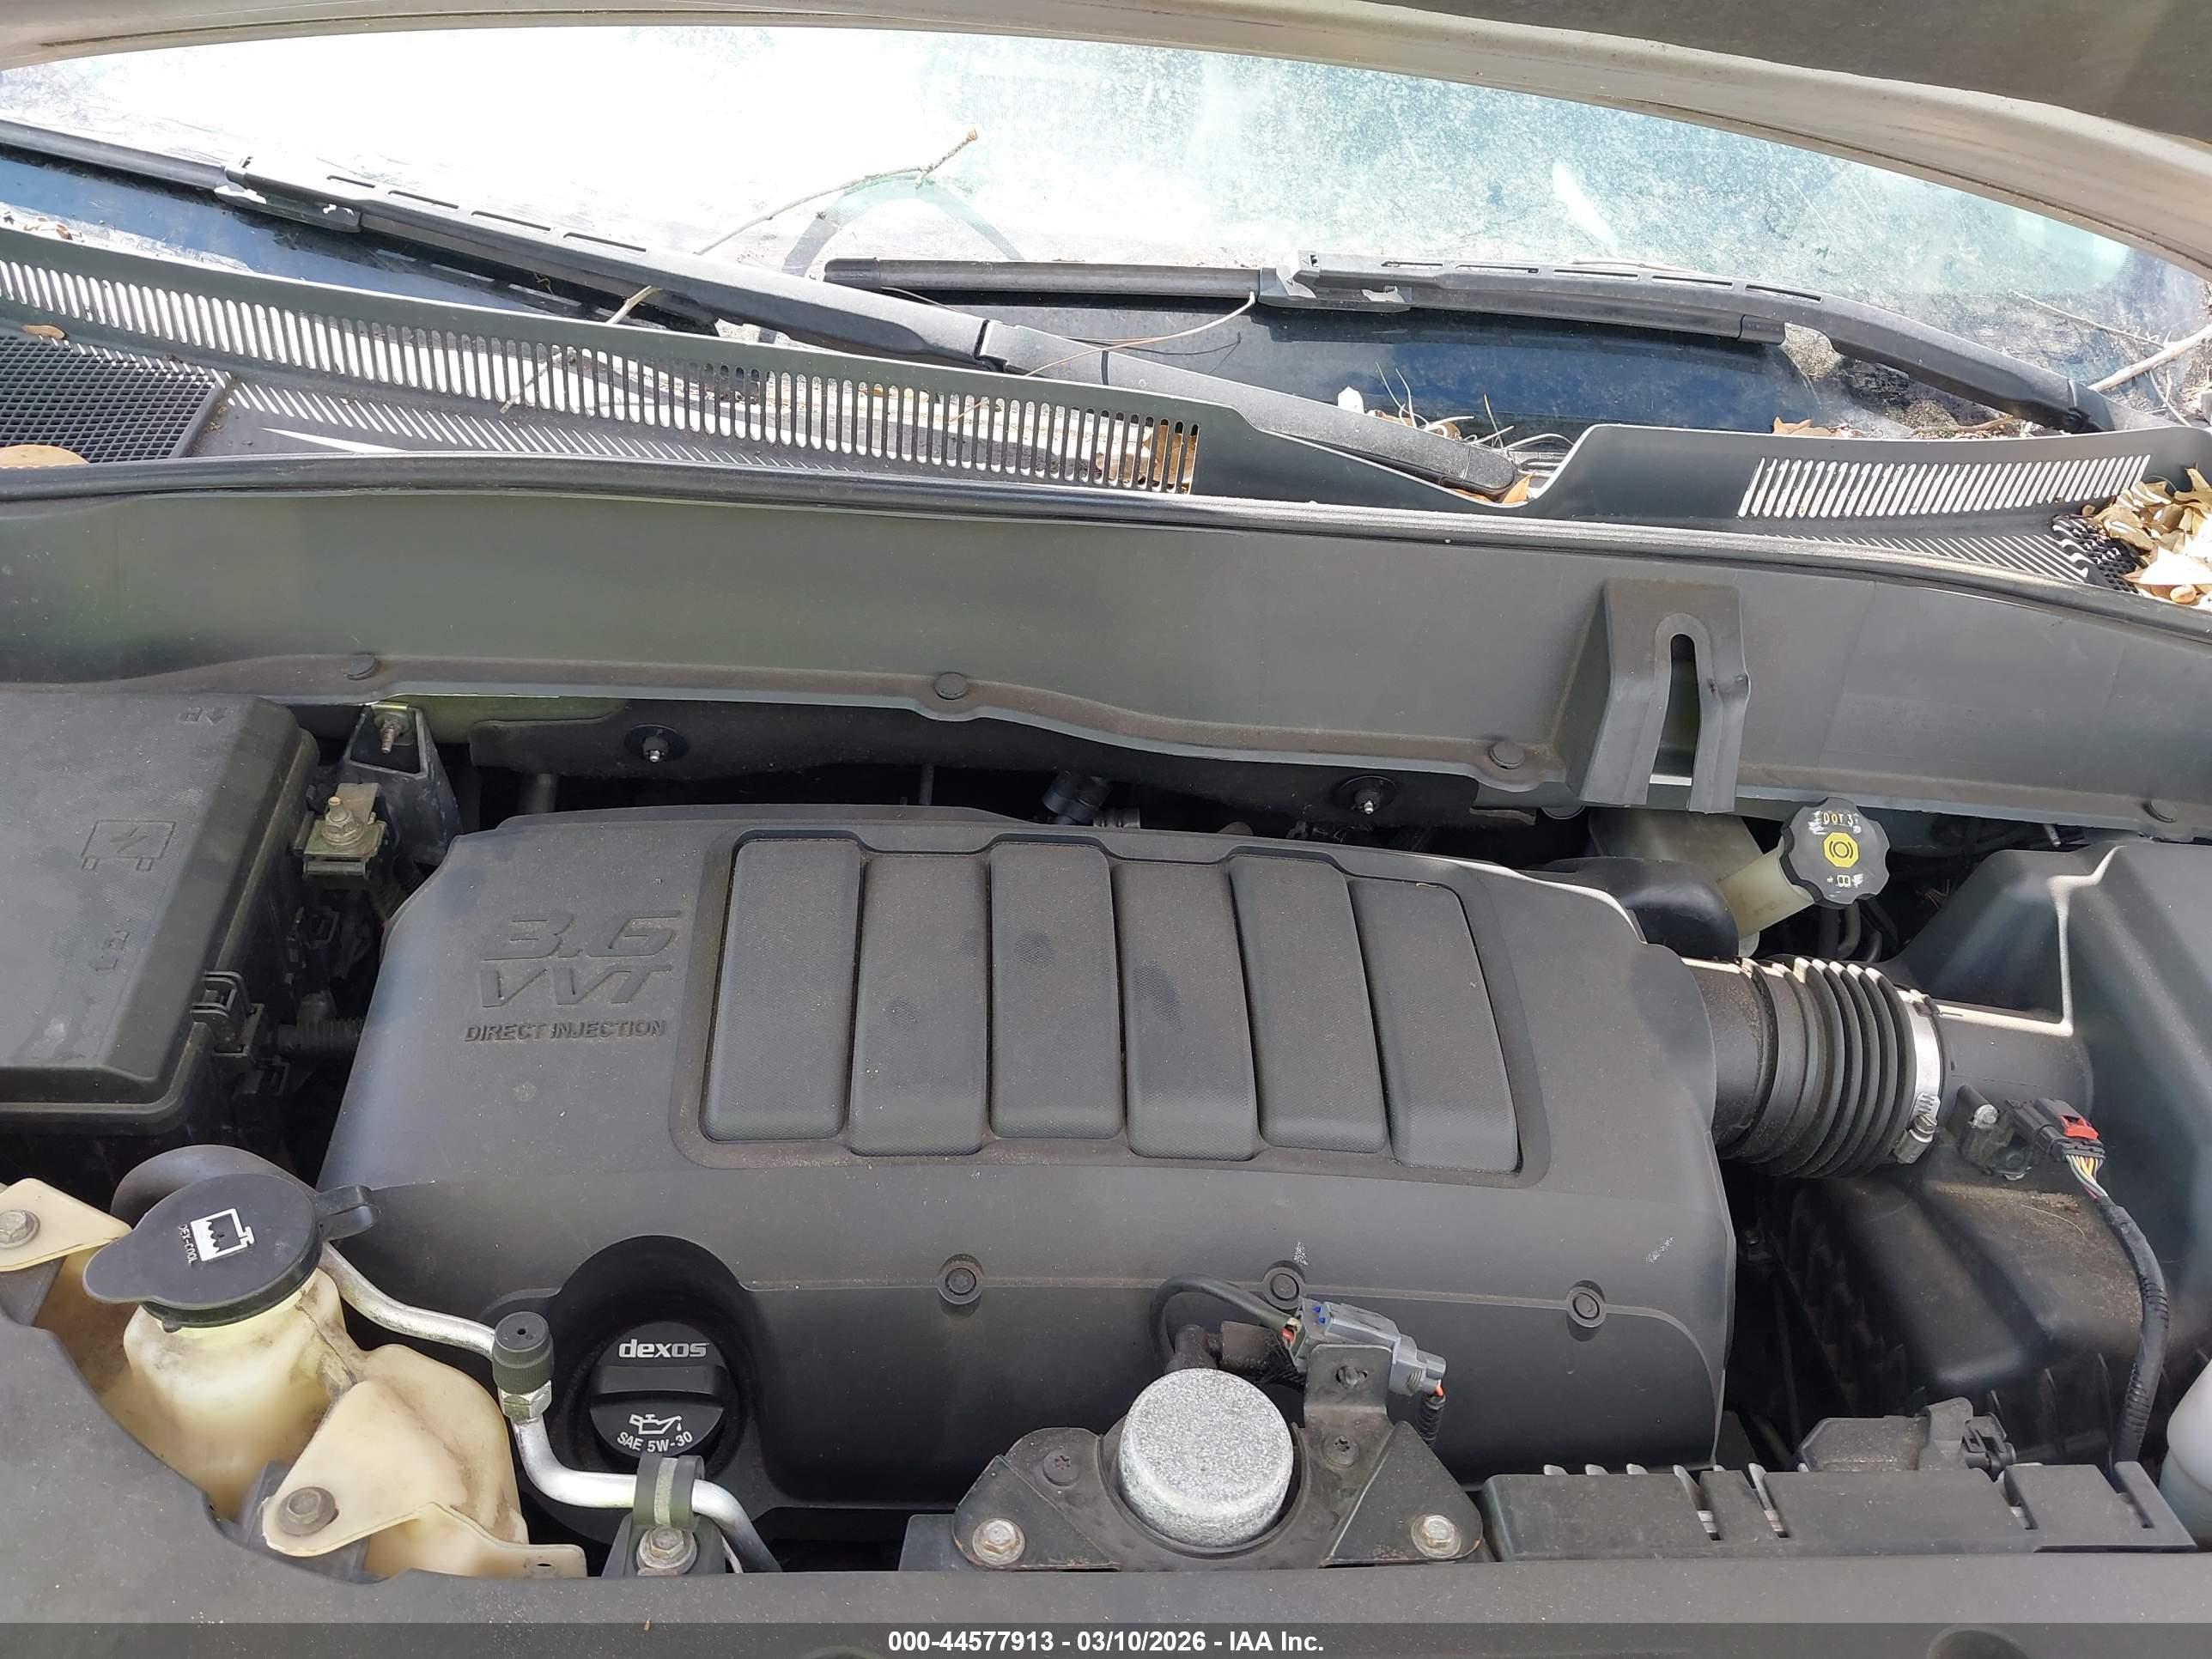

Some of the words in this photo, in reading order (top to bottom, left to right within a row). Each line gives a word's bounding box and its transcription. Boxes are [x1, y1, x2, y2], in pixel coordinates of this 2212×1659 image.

[1823, 812, 1844, 825] DOT
[1846, 813, 1854, 827] 3
[479, 911, 681, 961] 3.6
[479, 965, 673, 1007] VVT
[465, 1023, 545, 1042] DIRECT
[550, 1019, 666, 1039] INJECTION
[178, 1224, 198, 1264] DEX-COOL
[618, 1339, 708, 1358] dexos
[617, 1431, 643, 1451] SAE
[647, 1431, 693, 1453] 5W-30
